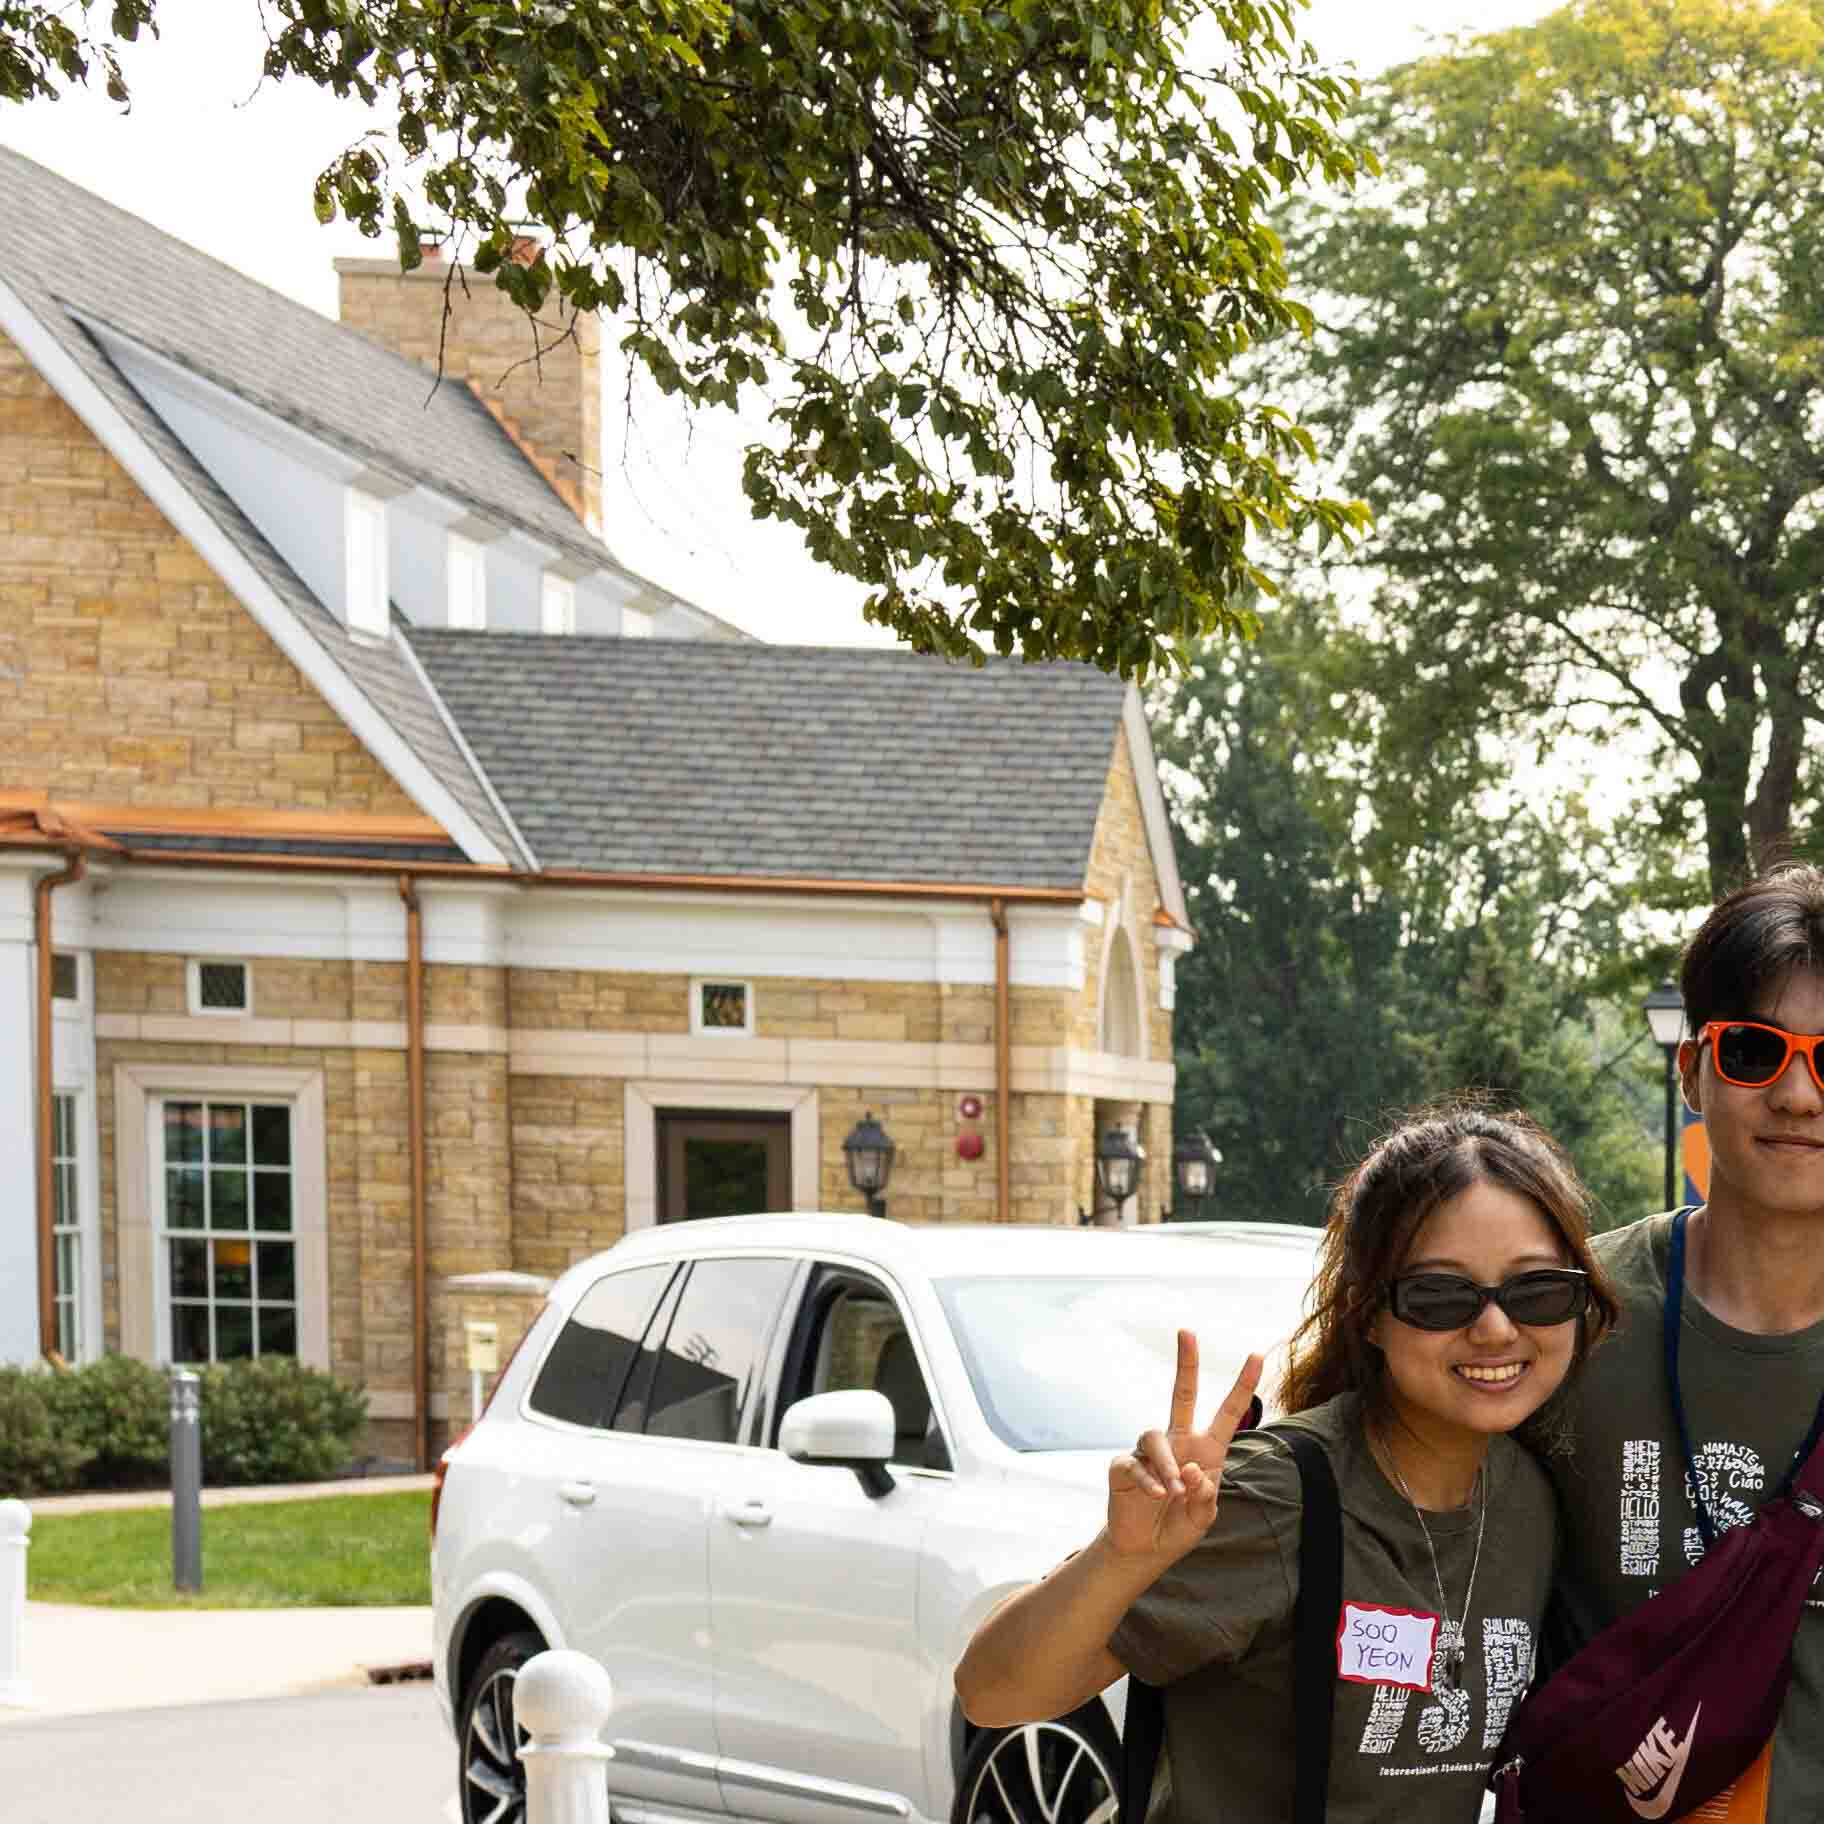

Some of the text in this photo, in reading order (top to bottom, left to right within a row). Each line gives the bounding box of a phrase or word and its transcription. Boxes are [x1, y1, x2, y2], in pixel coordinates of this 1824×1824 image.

[1352, 1619, 1398, 1643] SOO
[1357, 1643, 1415, 1672] YEON
[1615, 1716, 1684, 1797] NIKE
